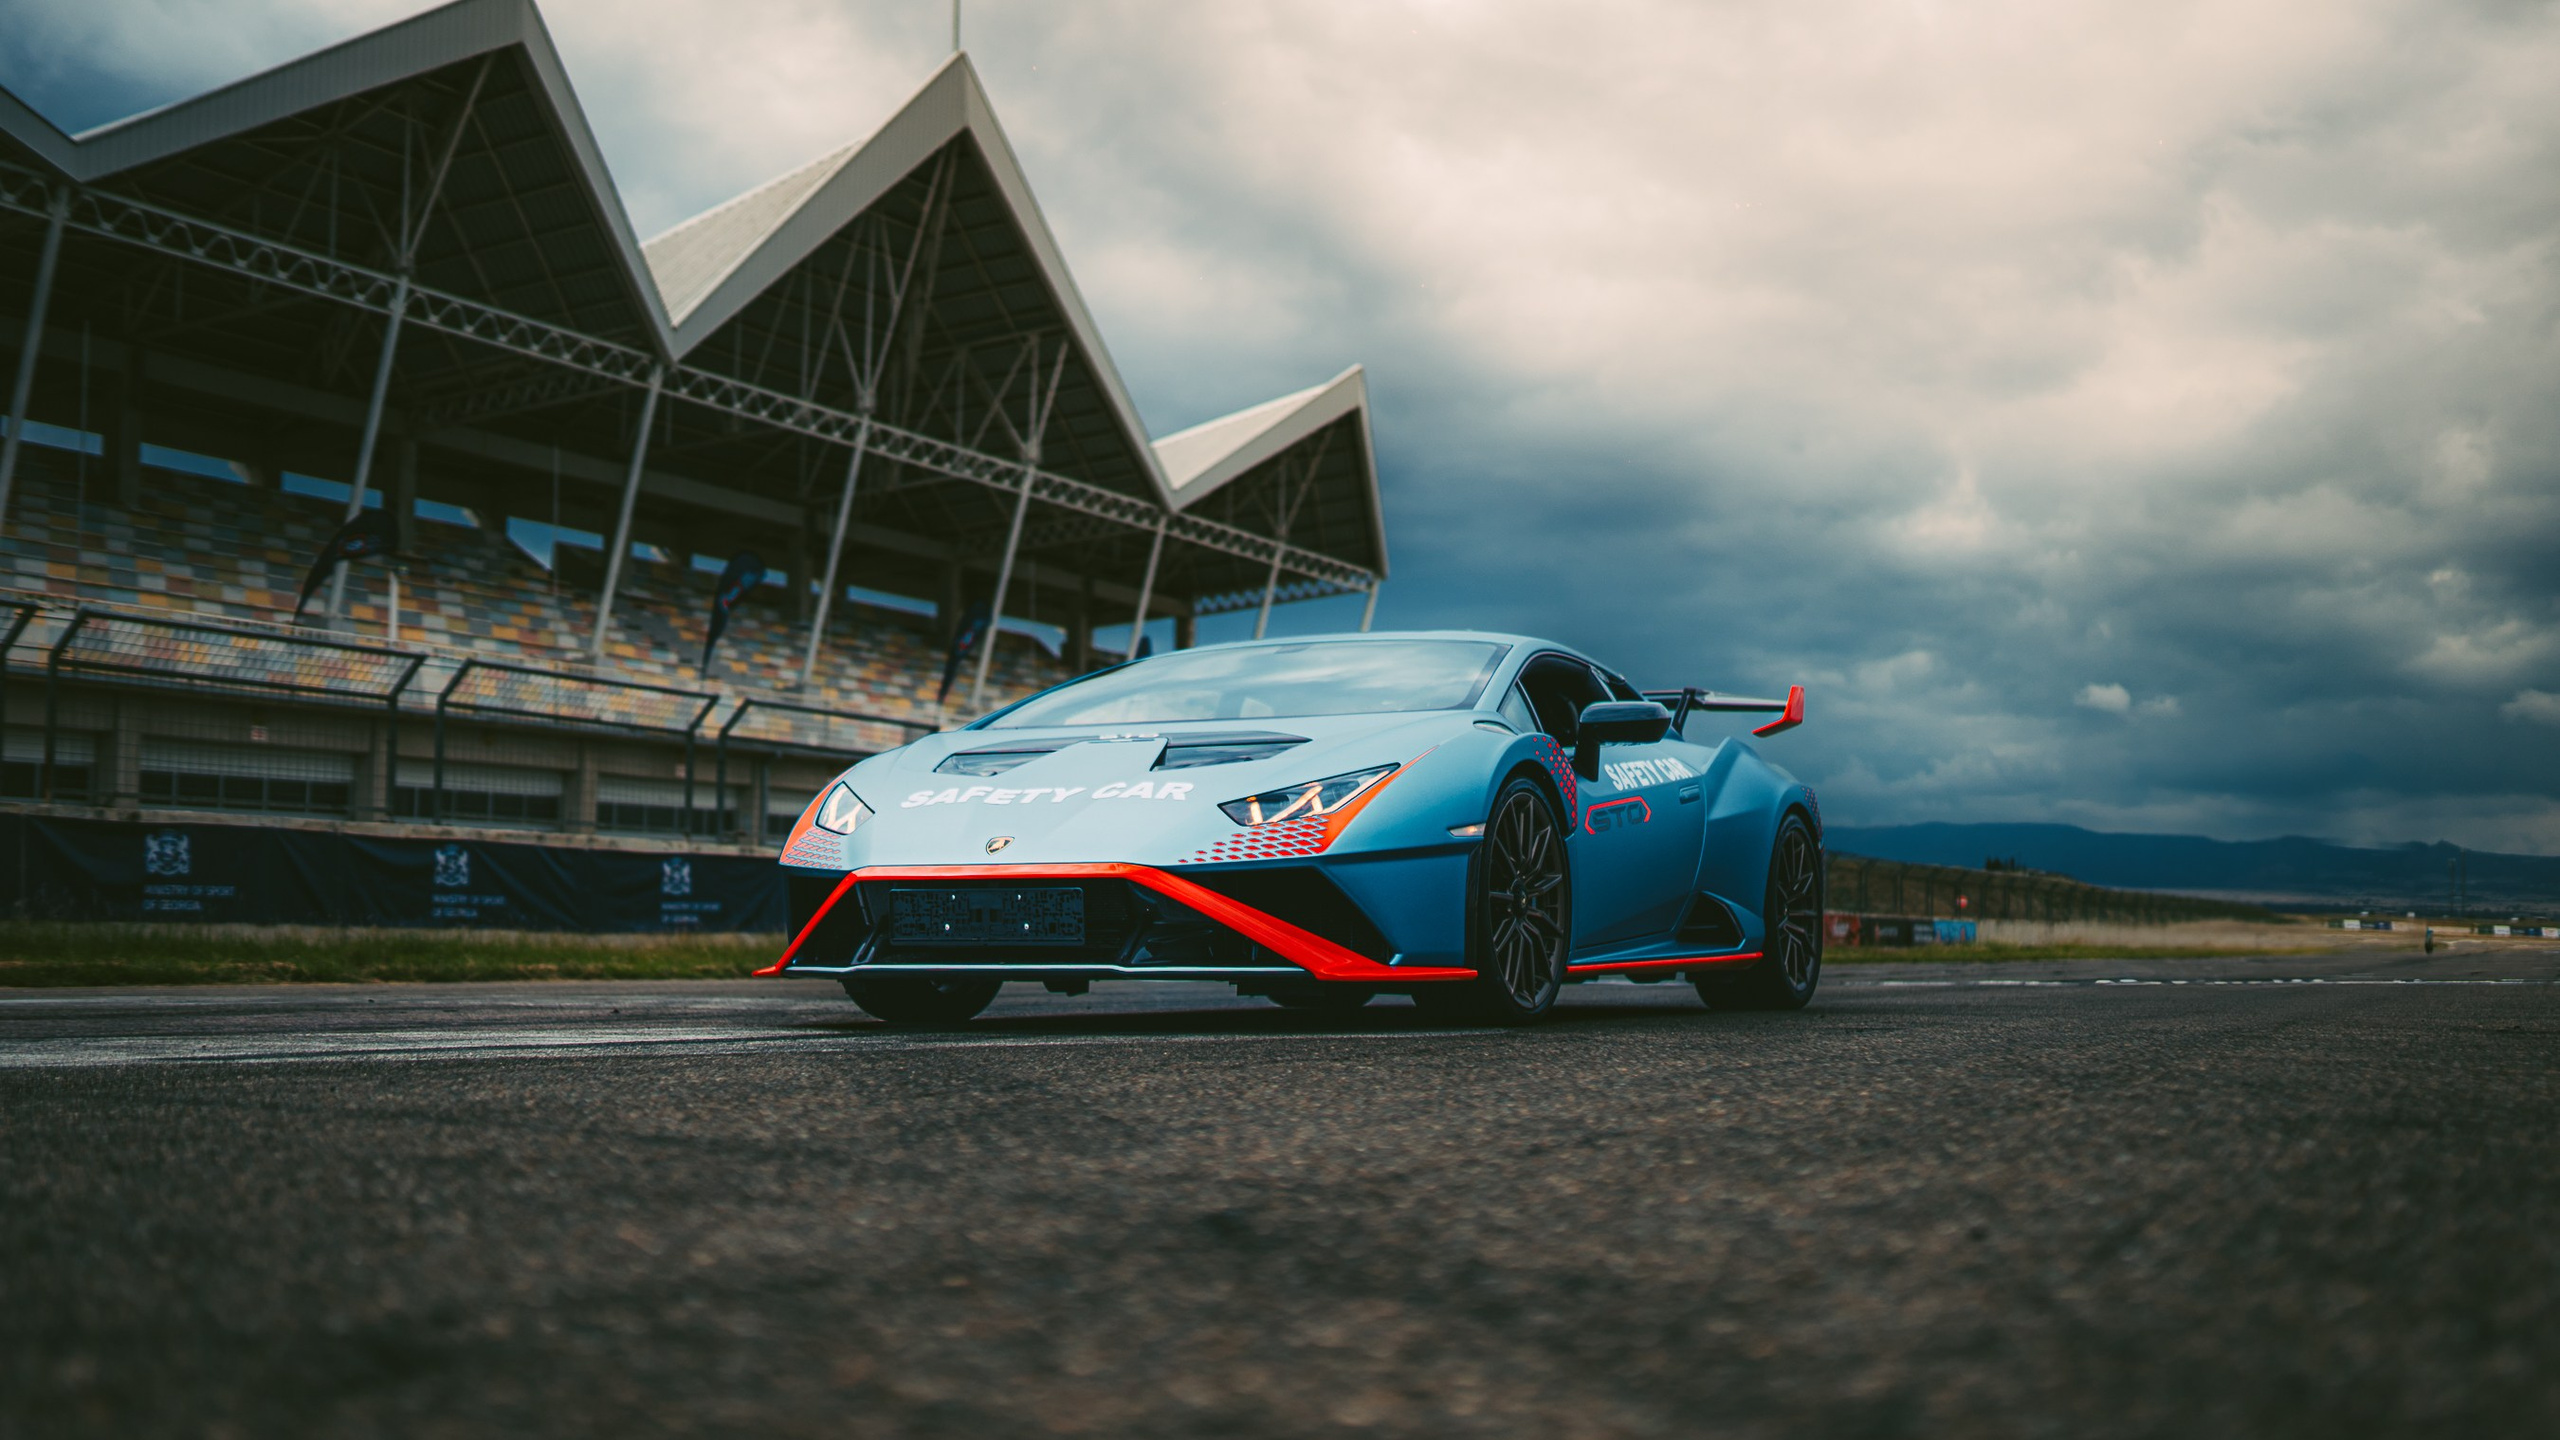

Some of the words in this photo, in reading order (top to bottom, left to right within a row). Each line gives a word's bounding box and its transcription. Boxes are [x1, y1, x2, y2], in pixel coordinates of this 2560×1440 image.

[1604, 760, 1664, 791] SAFETY
[1653, 757, 1693, 782] CAR
[901, 786, 1086, 809] SAFETY
[1091, 781, 1194, 801] CAR
[1592, 802, 1643, 832] STO
